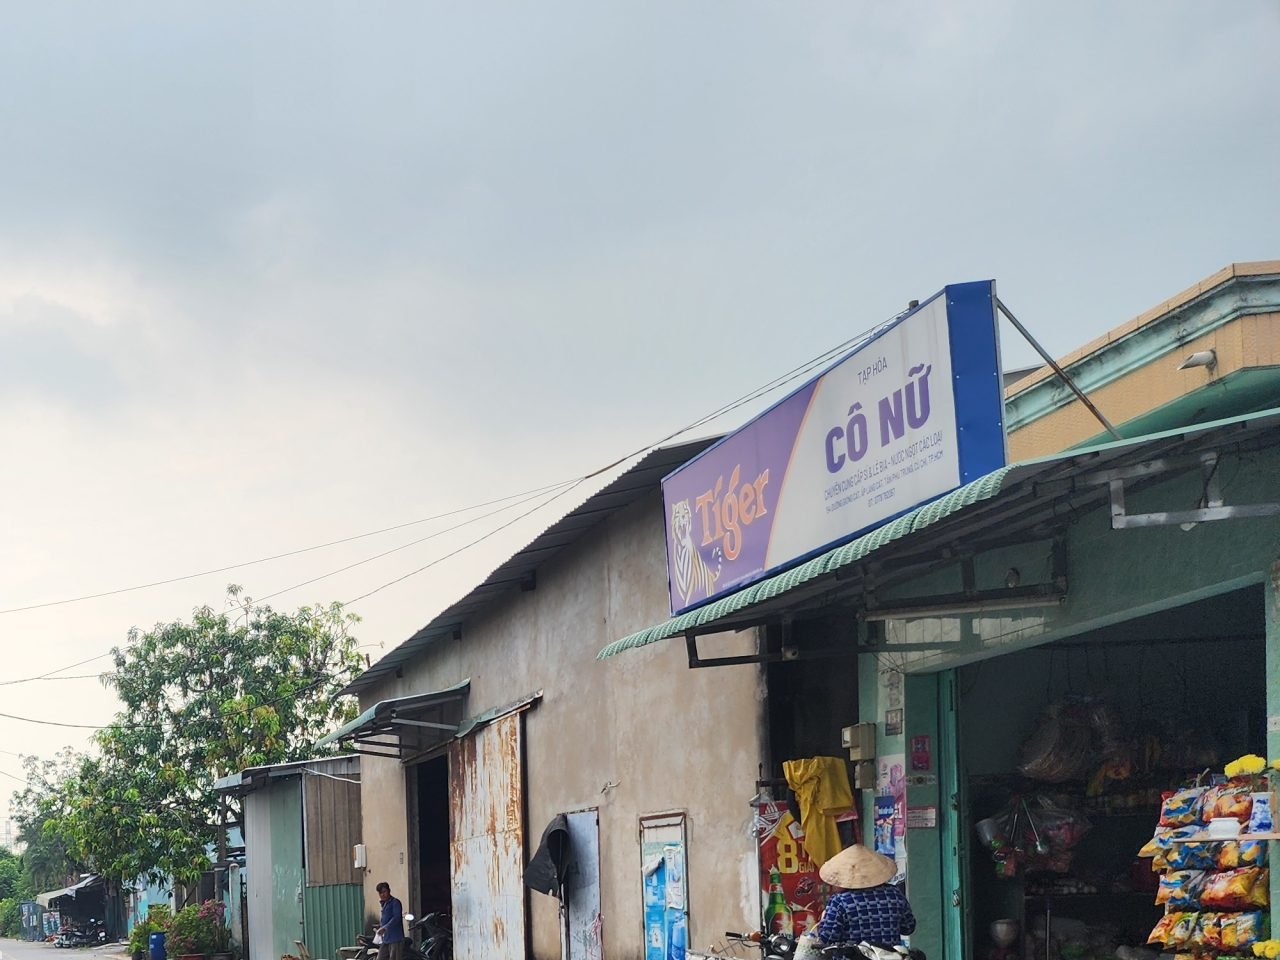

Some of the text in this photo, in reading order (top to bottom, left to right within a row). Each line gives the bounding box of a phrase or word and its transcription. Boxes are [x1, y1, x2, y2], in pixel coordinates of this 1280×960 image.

[857, 366, 872, 385] TẠP
[825, 363, 932, 474] CÔ NỮ
[695, 463, 769, 561] Tiger
[777, 836, 799, 873] 8
